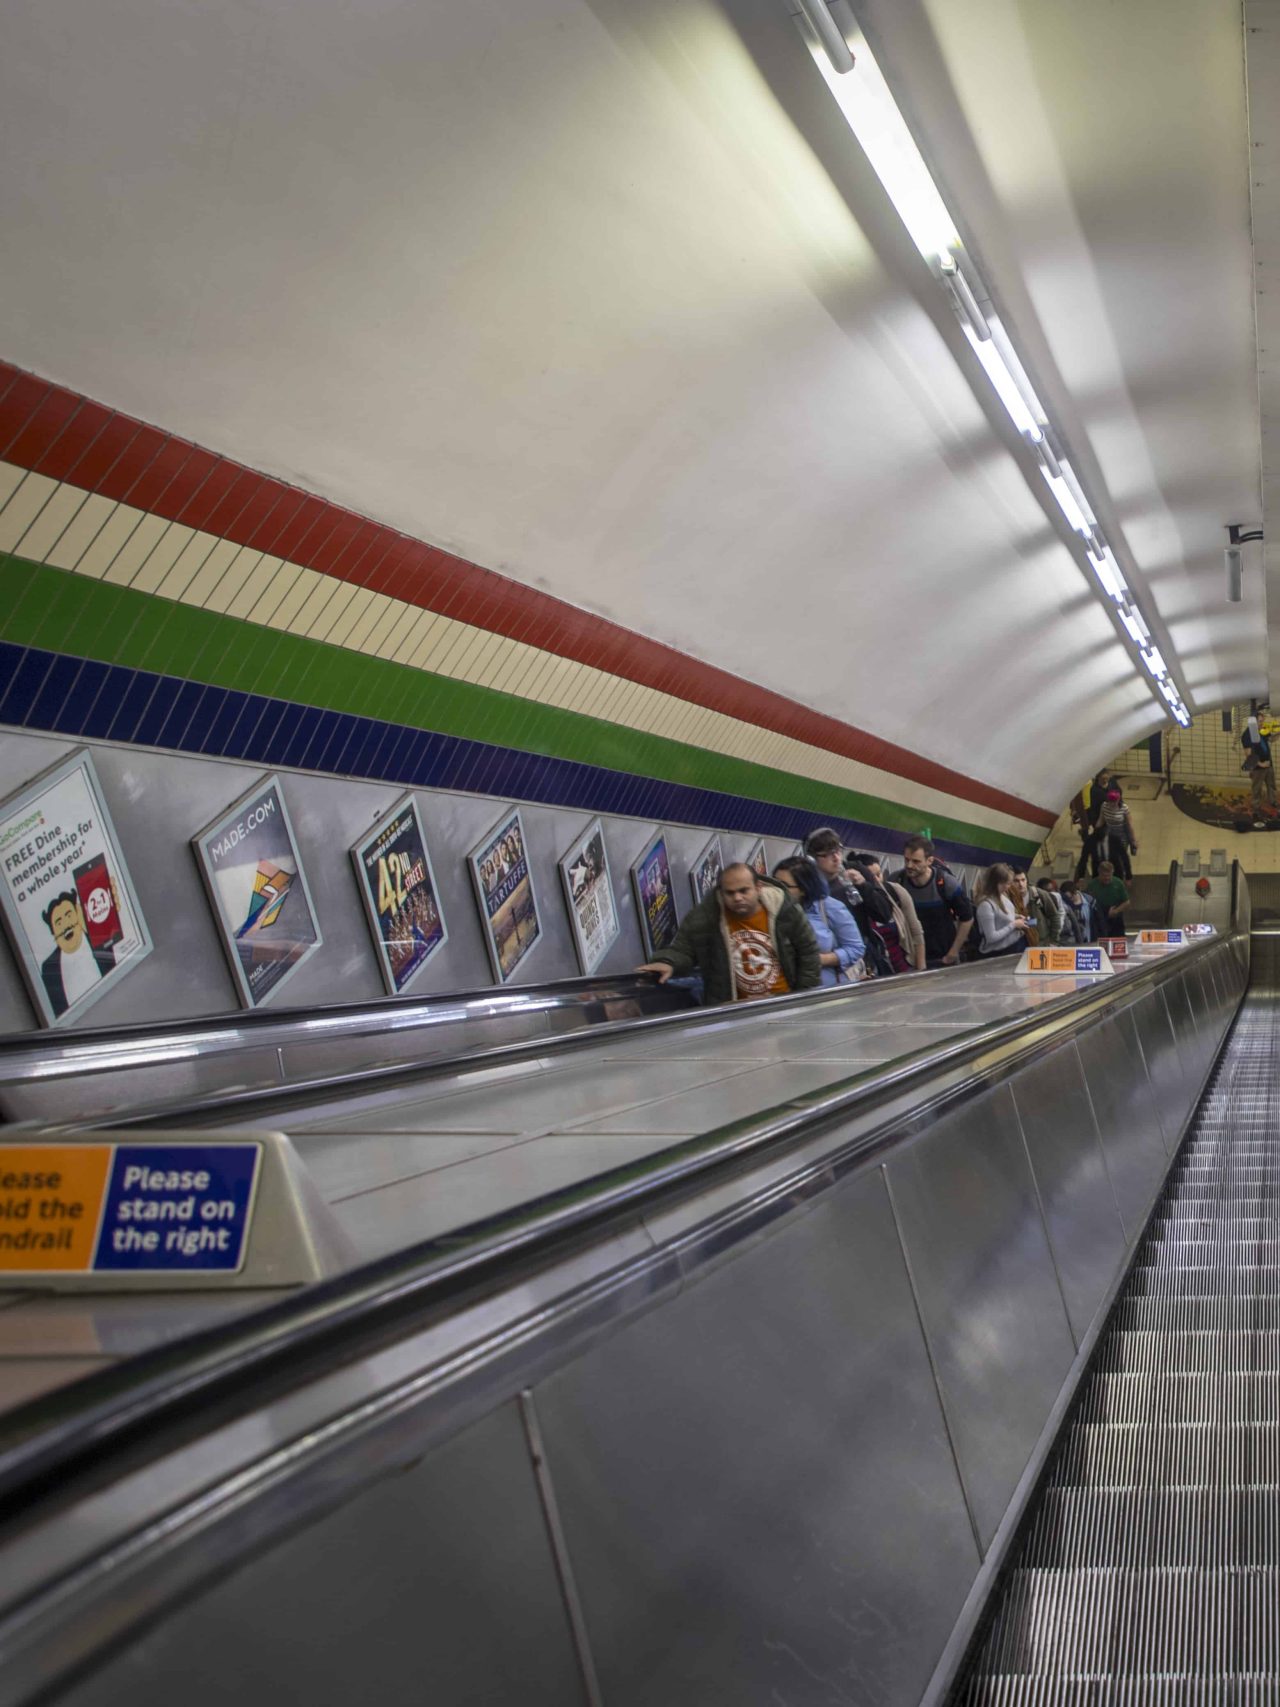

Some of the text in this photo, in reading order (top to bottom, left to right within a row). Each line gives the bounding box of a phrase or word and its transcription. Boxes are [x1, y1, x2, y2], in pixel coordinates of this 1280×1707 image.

[212, 797, 275, 863] MADE.COM
[5, 842, 35, 872] FREE
[35, 825, 62, 850] Dine
[12, 832, 78, 887] membership
[77, 818, 93, 836] for
[18, 891, 27, 902] a
[27, 865, 60, 895] whole
[404, 862, 425, 892] STREET
[488, 860, 527, 913] TARTUFFE
[0, 1170, 62, 1190] ease
[123, 1165, 211, 1190] Please
[39, 1197, 84, 1219] the
[117, 1196, 235, 1221] stand on
[0, 1227, 74, 1250] ndrail
[112, 1226, 231, 1256] the right
